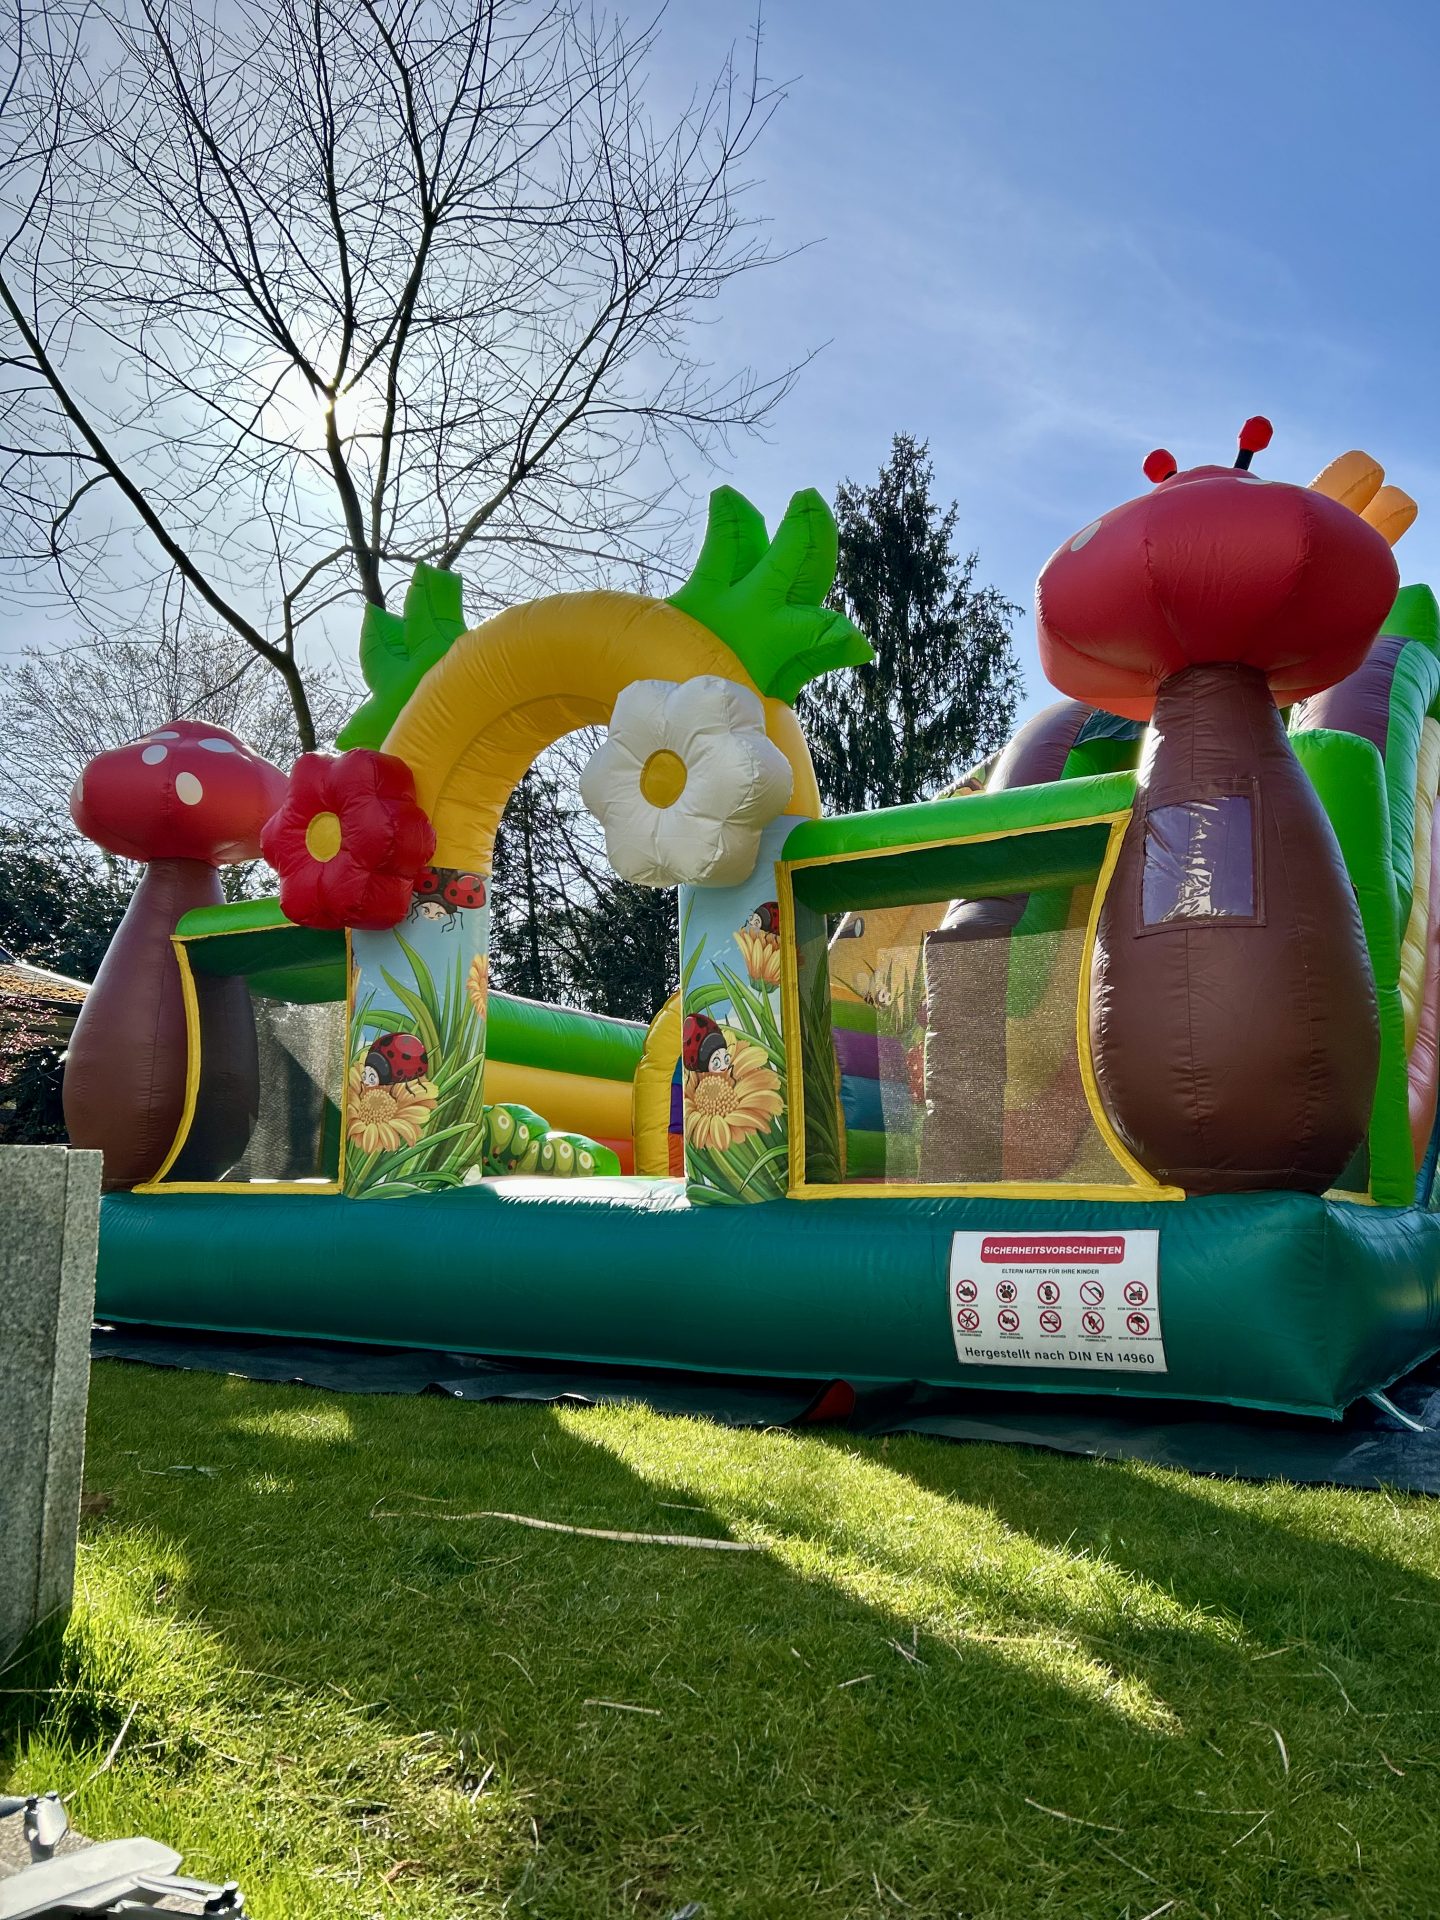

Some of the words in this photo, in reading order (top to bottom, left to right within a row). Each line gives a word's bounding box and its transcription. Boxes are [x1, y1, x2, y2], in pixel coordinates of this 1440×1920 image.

[983, 1246, 1122, 1255] SICHERHEITSVORSCHRIFTEN
[965, 1347, 1031, 1360] Hergestellt
[1034, 1350, 1065, 1361] nach
[1069, 1351, 1092, 1361] DIN
[1096, 1352, 1114, 1362] EN
[1118, 1353, 1155, 1364] 14960
